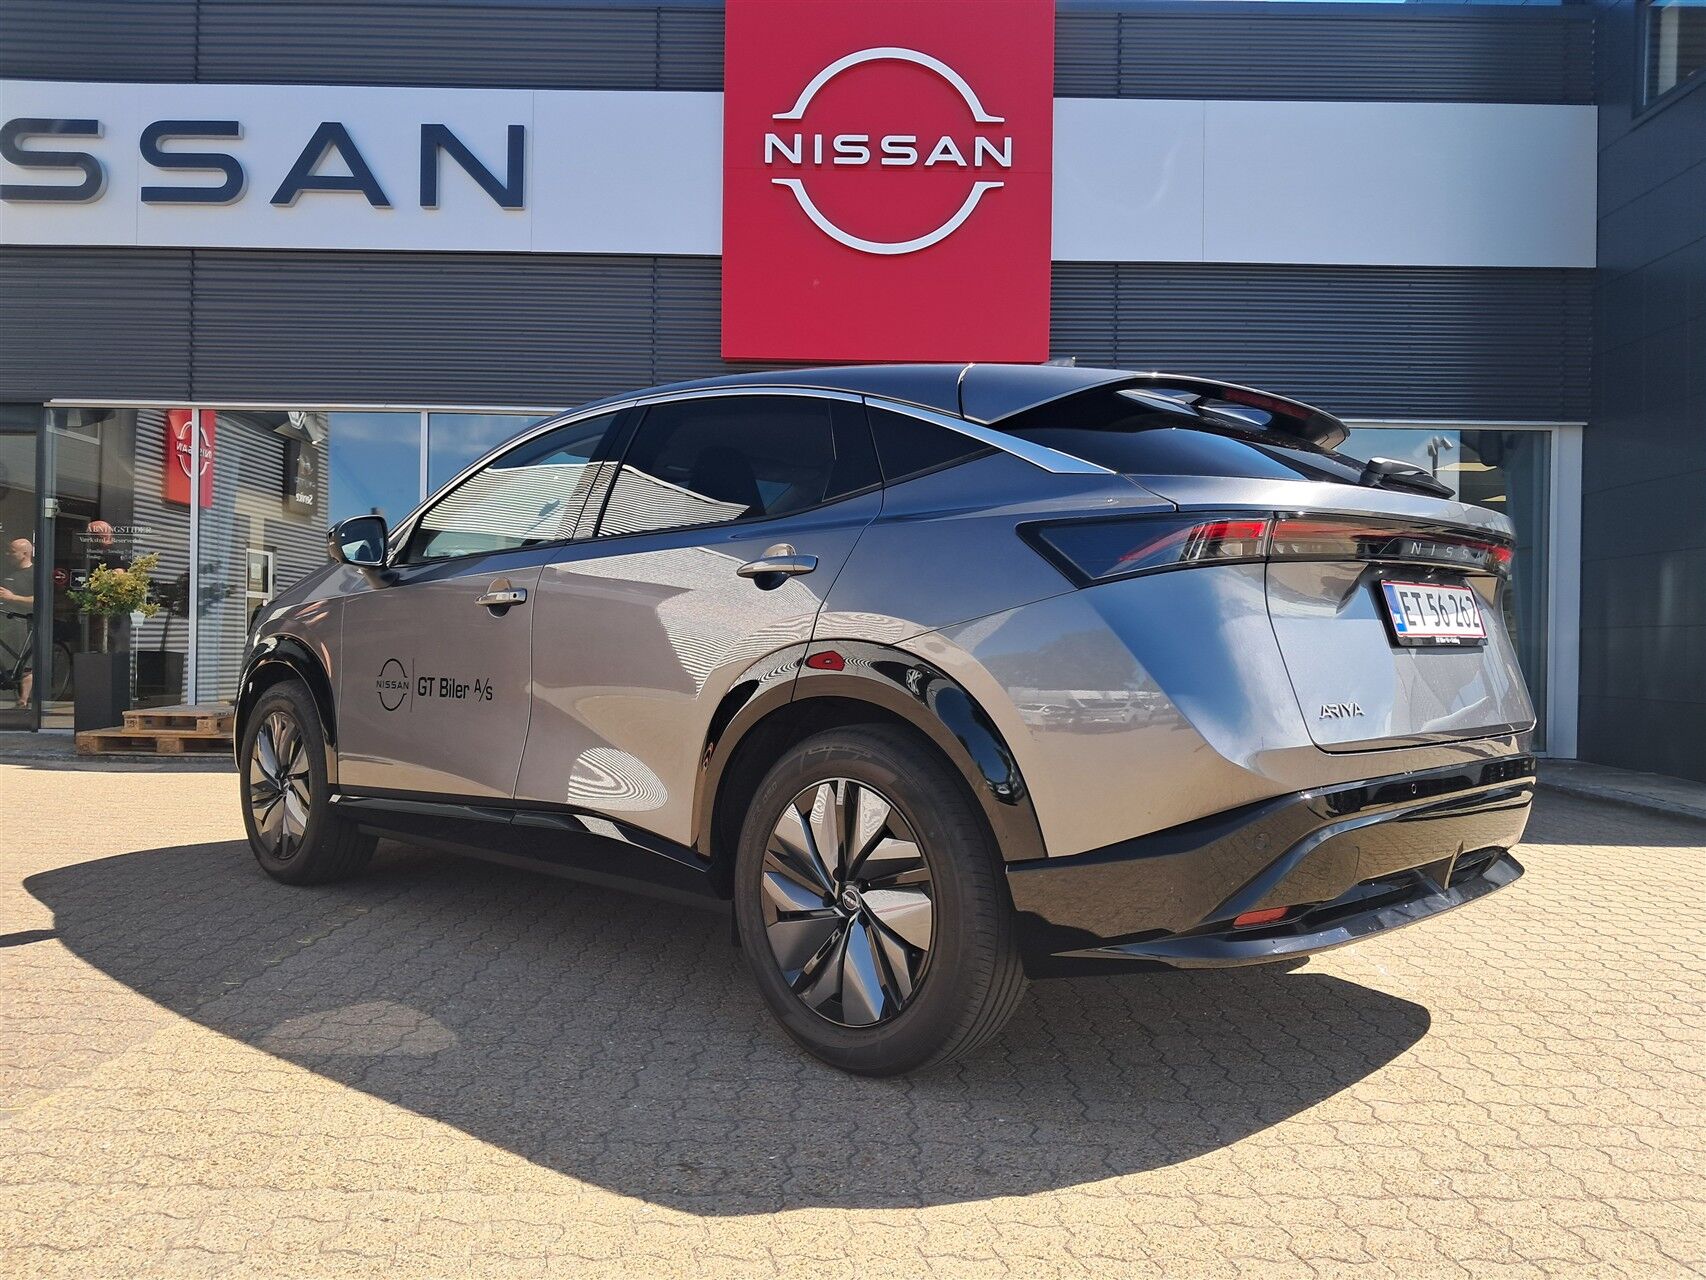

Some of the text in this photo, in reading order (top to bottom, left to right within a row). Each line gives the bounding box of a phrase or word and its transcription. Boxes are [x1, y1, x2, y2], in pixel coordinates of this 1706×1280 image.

[764, 133, 1012, 167] NISSAN
[1399, 591, 1480, 628] ET 56 262
[376, 680, 409, 689] NISSAN
[418, 676, 435, 696] GT
[440, 677, 470, 699] Biler
[1319, 702, 1365, 719] ARIYA
